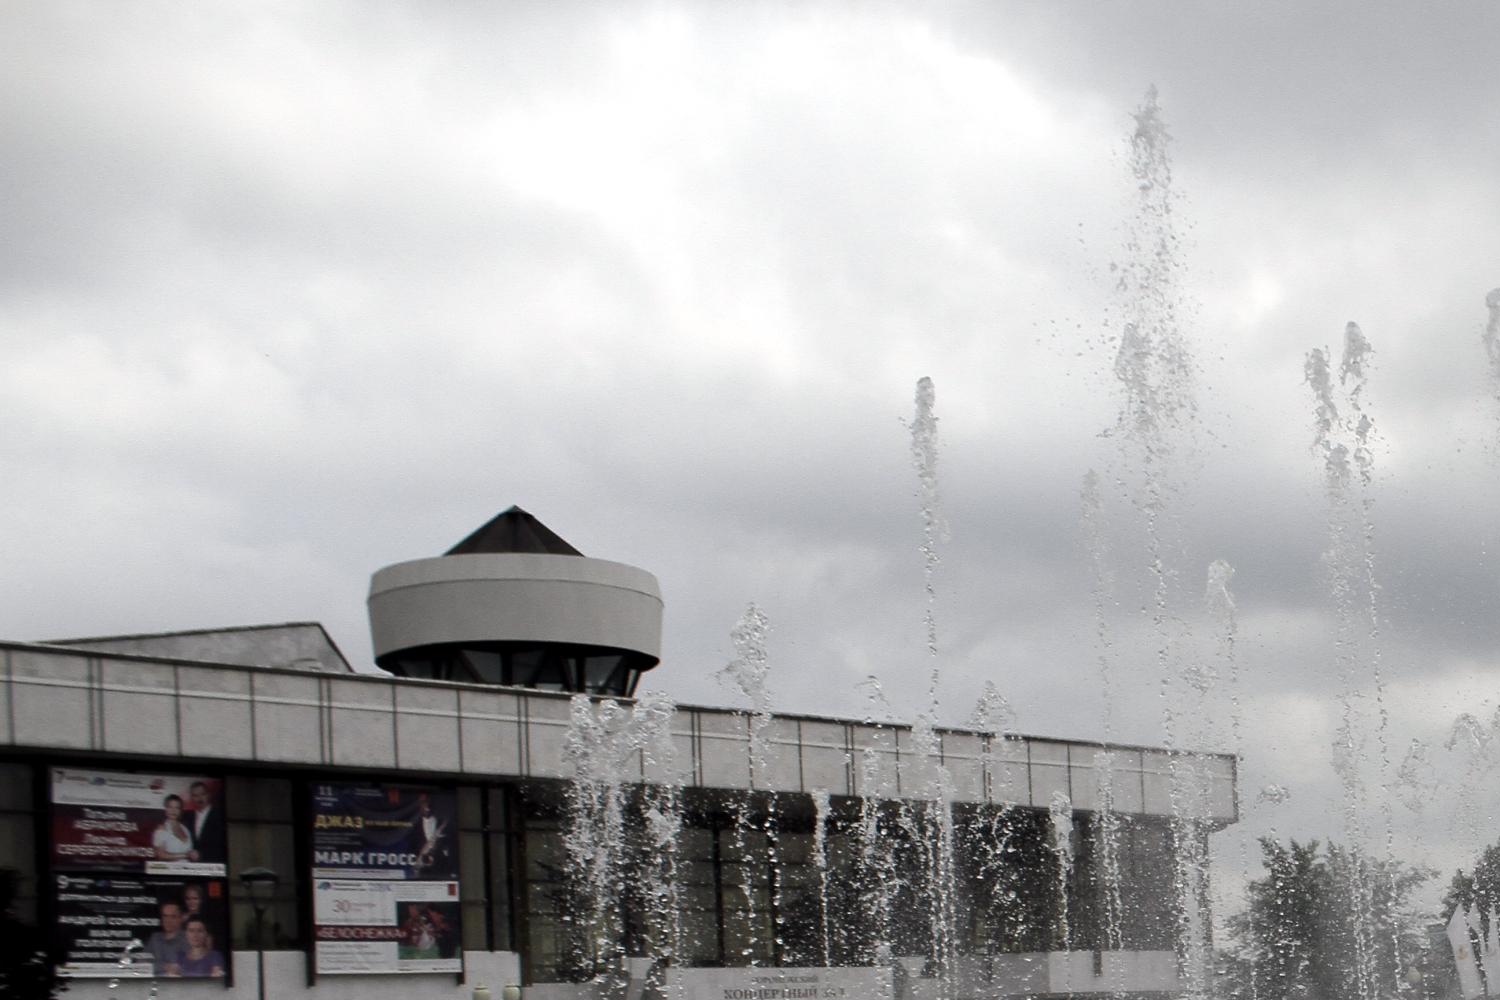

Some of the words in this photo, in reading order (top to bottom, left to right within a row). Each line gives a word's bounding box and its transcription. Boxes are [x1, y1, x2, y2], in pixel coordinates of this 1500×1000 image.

[315, 815, 364, 829] ДЖАЗ
[315, 851, 364, 865] МАРК
[367, 852, 418, 866] ГРОСС
[57, 875, 69, 889] 9
[332, 899, 352, 913] 30
